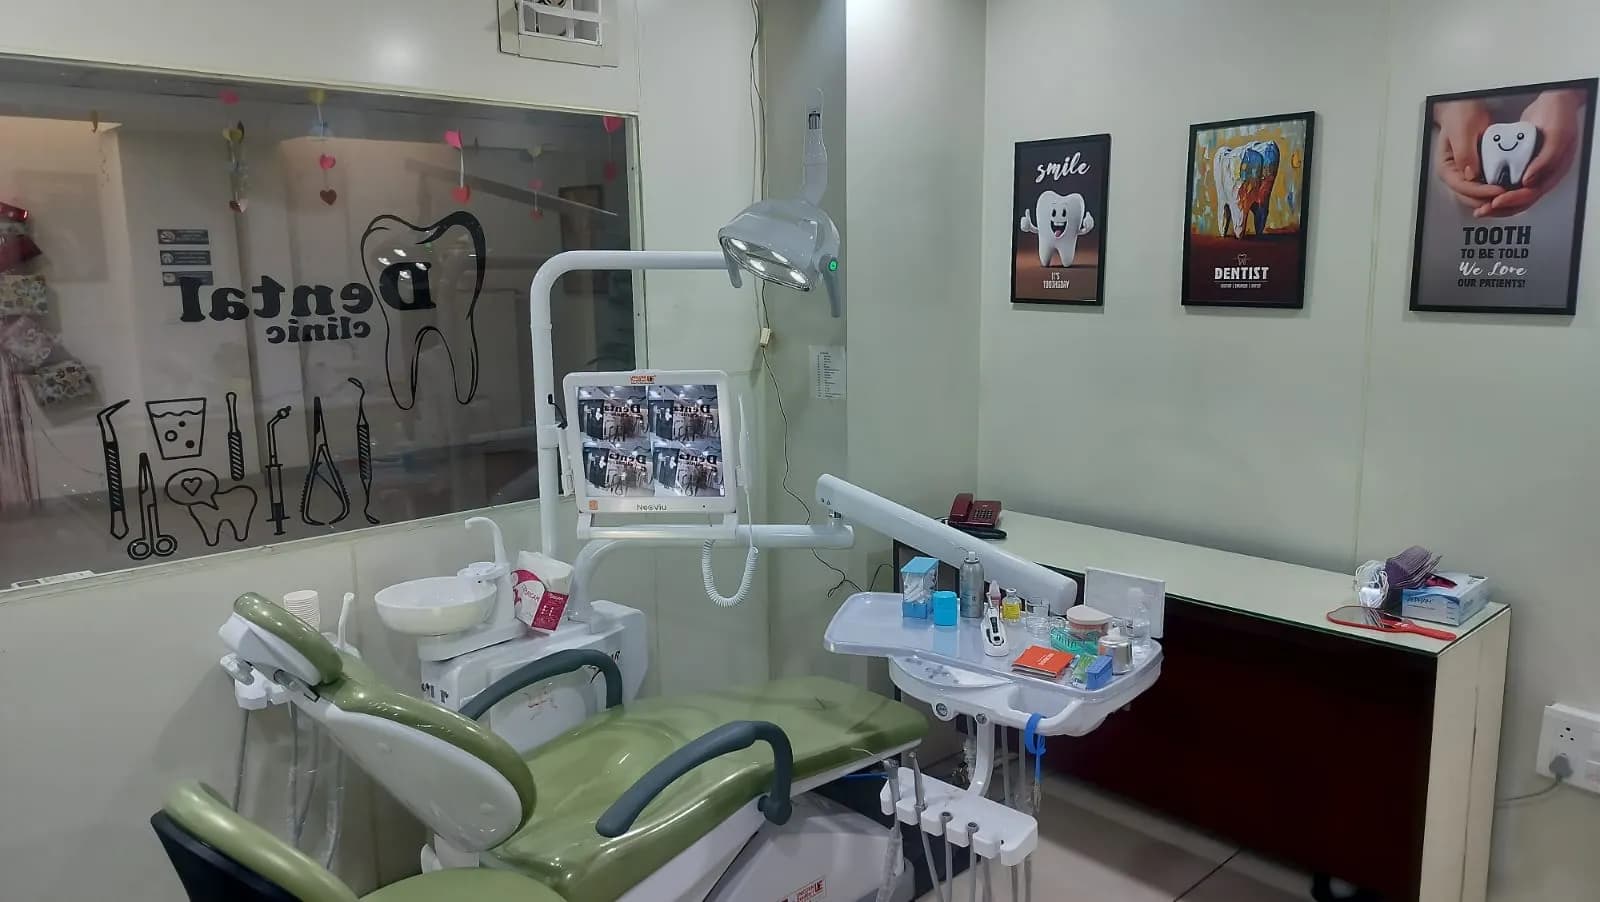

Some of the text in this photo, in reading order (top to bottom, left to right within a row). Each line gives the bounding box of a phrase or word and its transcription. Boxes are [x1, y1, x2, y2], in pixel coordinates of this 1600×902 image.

[1035, 151, 1091, 183] smile
[1463, 225, 1531, 245] TOOTH
[1461, 247, 1529, 259] TO BE TOLD
[1214, 266, 1270, 280] DENTIST
[1458, 261, 1528, 276] We Love
[1457, 278, 1526, 288] OUR PATIENTS!
